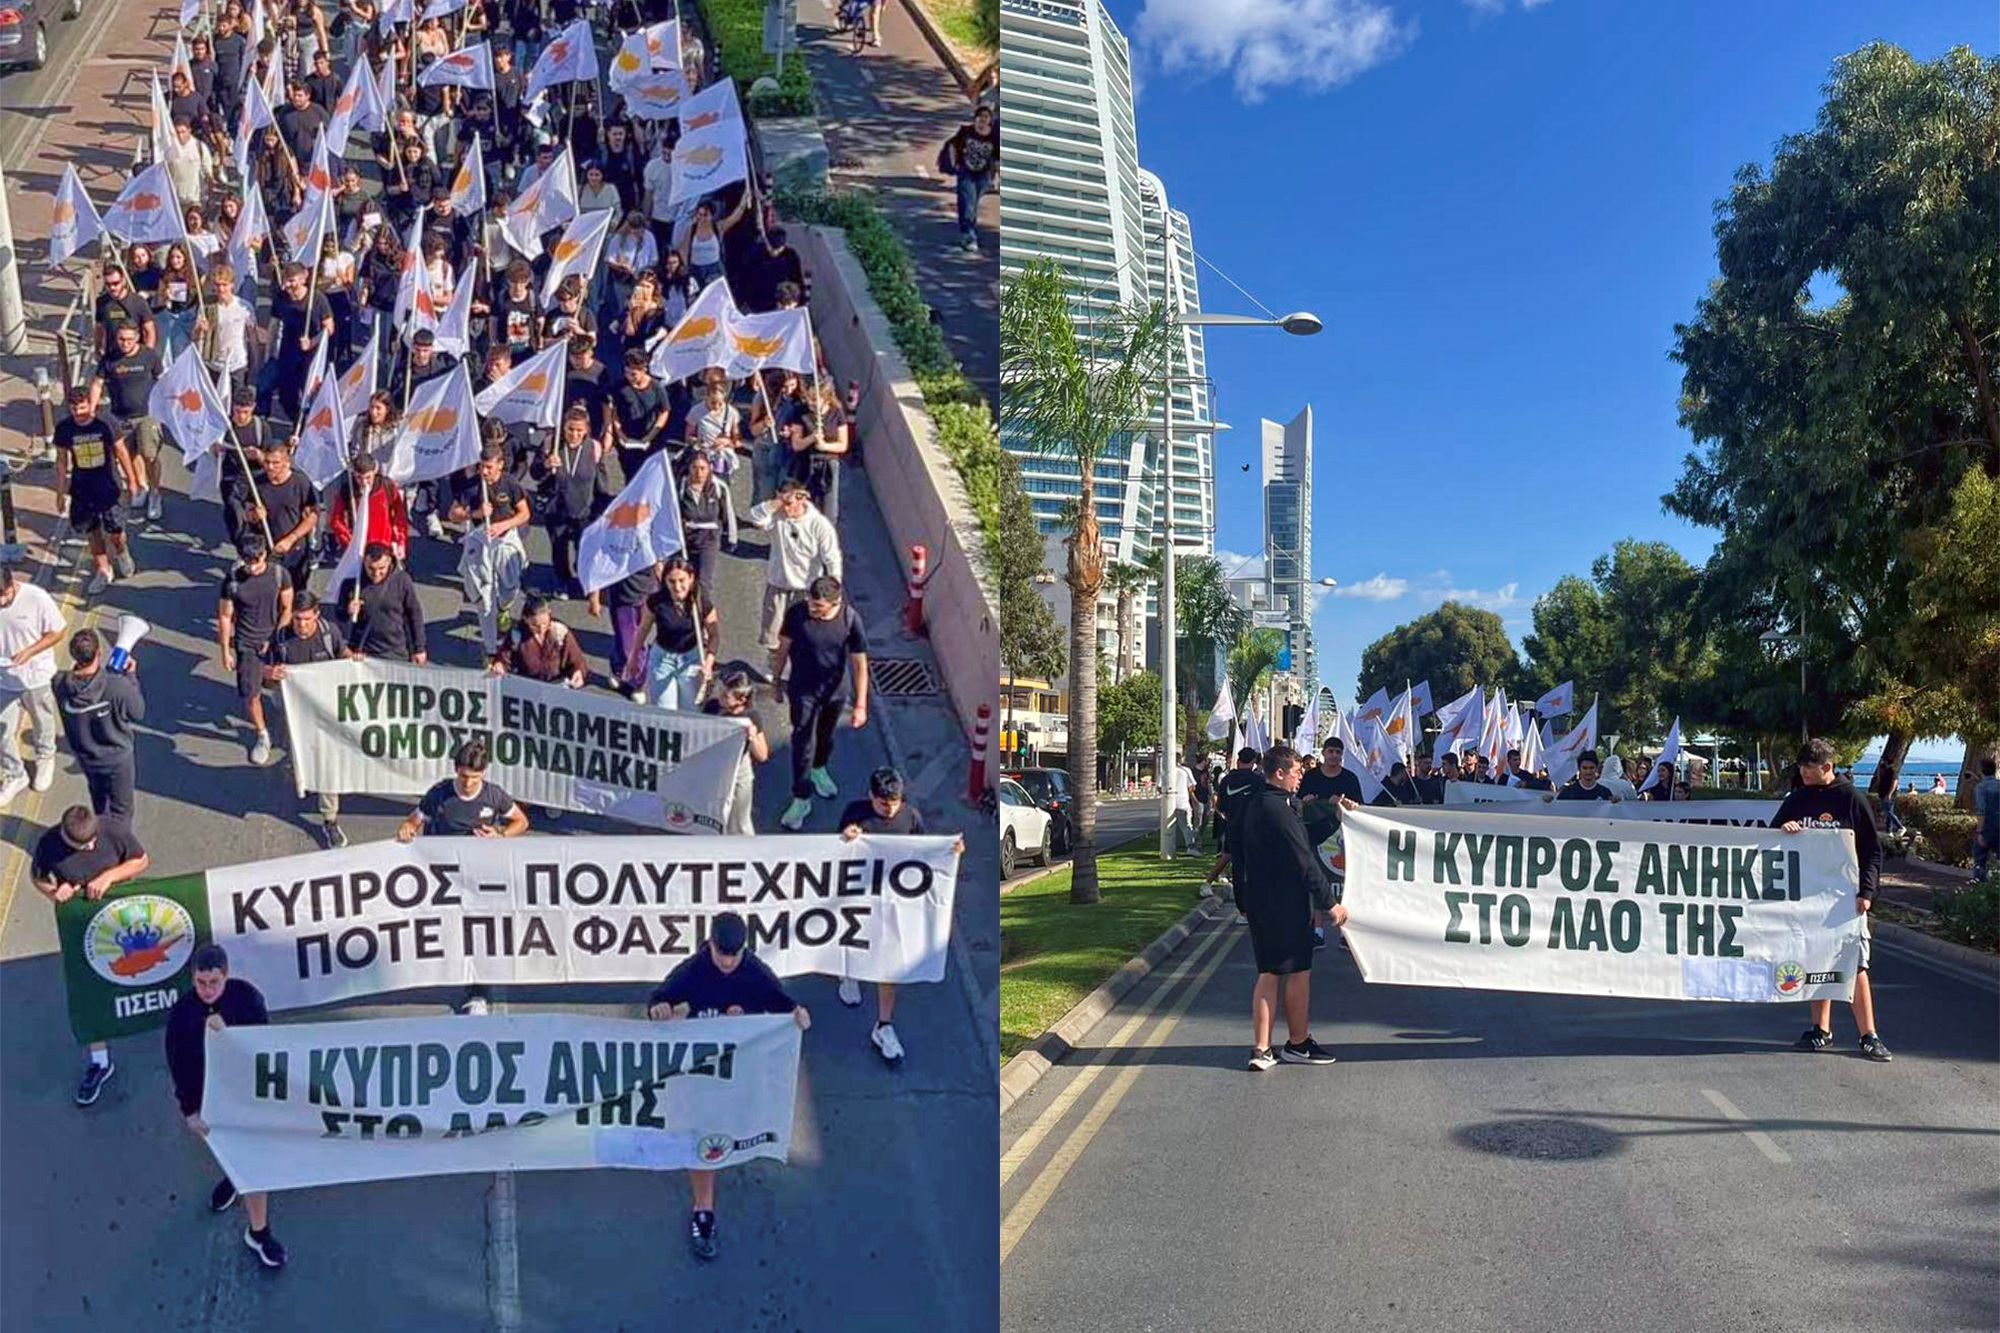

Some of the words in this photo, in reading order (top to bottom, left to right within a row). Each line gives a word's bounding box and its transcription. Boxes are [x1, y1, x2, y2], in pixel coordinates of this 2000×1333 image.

[338, 683, 487, 725] ΚΥΠΡΟΣ
[502, 696, 682, 762] ΕΝΩΜΕΝΗ
[232, 864, 461, 935] ΚΥΠΡΟΣ
[526, 859, 933, 905] ΠΟΛΥΤΕΧΝΕΙΟ
[1387, 829, 1416, 881] Η
[1433, 832, 1620, 892] ΚΥΠΡΟΣ
[1635, 843, 1800, 901] ΑΝΗΚΕΙ
[296, 917, 444, 979] ΠΟΤΕ
[463, 916, 557, 956] ΠΙΑ
[573, 907, 871, 956] ΦΑΣΙΜΟΣ
[1444, 891, 1531, 947] ΣΤΟ
[1547, 897, 1641, 953] ΛΑΟ
[1659, 902, 1744, 957] ΤΗΣ
[115, 988, 178, 1018] ΠΣΕΜ
[1810, 973, 1835, 984] ΠΣΕΜ
[255, 1052, 288, 1099] Η
[309, 1041, 526, 1107] ΚΥΠΡΟΣ
[544, 1041, 736, 1104] ΑΝΗΚΕΙ
